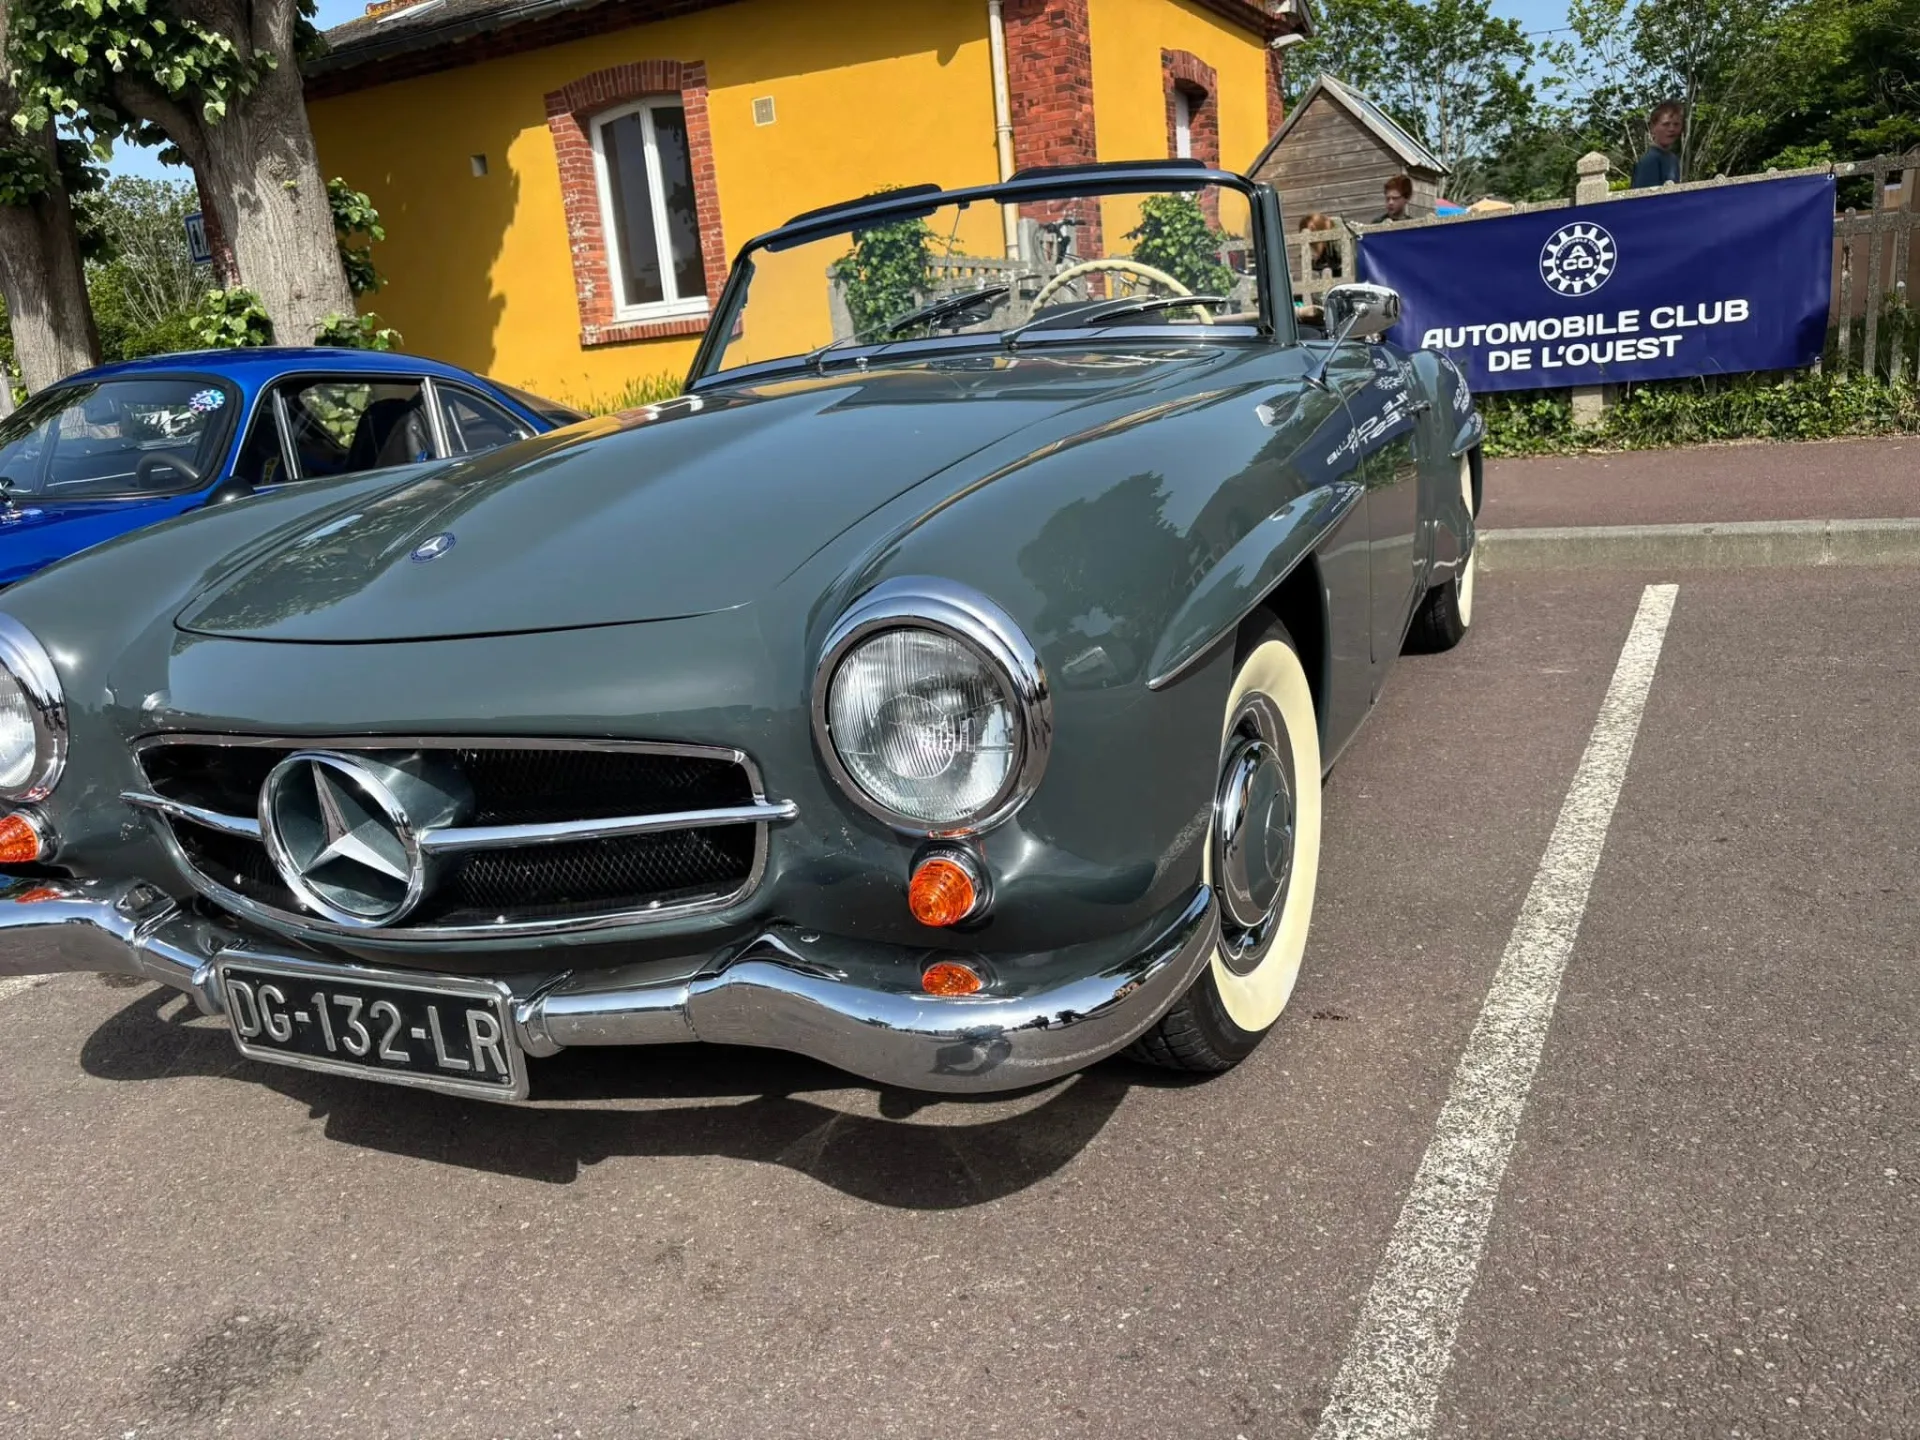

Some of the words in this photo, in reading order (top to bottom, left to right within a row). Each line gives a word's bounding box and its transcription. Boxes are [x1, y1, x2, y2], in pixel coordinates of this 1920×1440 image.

[1421, 309, 1640, 350] AUTOMOBILE
[1650, 299, 1749, 330] CLUB
[1488, 351, 1532, 373] DE
[1541, 335, 1683, 368] L'OUEST
[226, 979, 509, 1075] DG-132-LR
